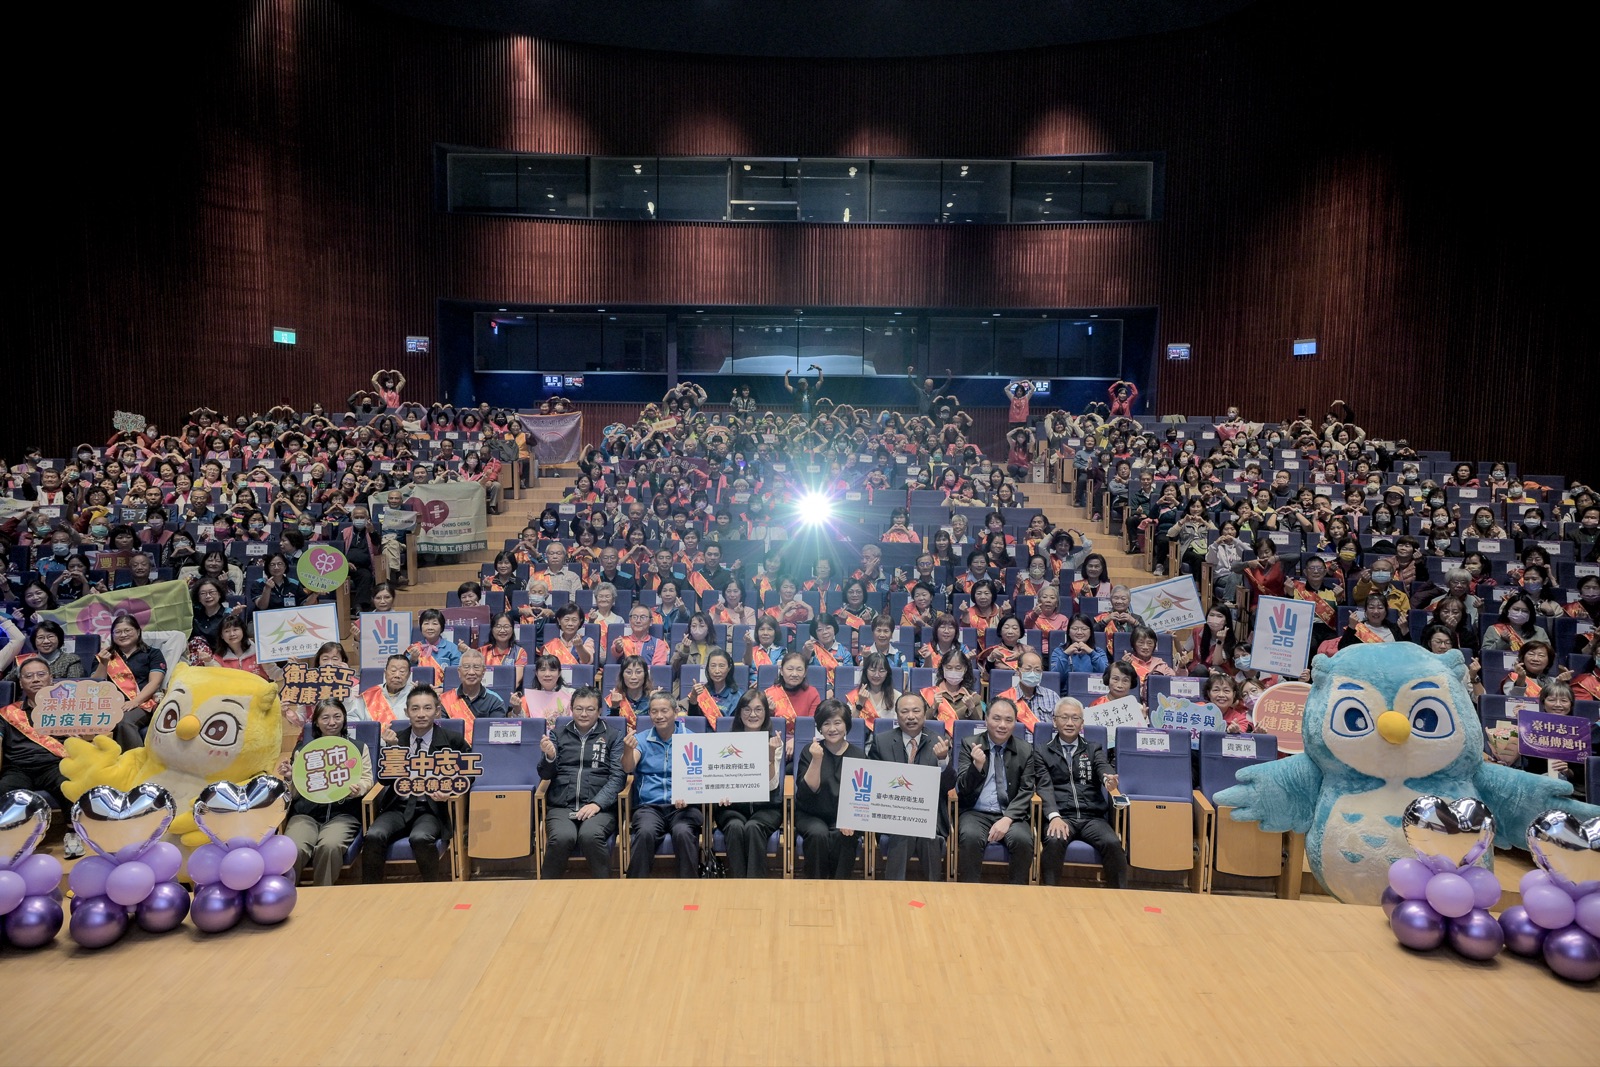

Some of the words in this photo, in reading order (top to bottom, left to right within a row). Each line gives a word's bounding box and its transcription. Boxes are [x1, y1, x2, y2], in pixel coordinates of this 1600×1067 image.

[1272, 635, 1294, 648] 26
[378, 645, 399, 655] 26
[284, 664, 355, 686] 衛愛志工
[43, 697, 112, 711] 深耕社區
[41, 712, 111, 727] 防疫有力
[1163, 710, 1215, 727] 高齡參與
[494, 730, 517, 738] 貴賓席
[1532, 720, 1580, 736] 臺中志工
[1141, 737, 1165, 746] 貴賓席
[1227, 743, 1251, 752] 貴賓席
[1527, 733, 1587, 751] 幸福傳遞中
[304, 746, 347, 770] 富市
[380, 748, 483, 777] 臺中志工
[687, 766, 703, 775] 26
[708, 763, 755, 771] 臺中市政府衛生局
[307, 767, 350, 792] 臺中
[398, 779, 466, 793] 幸福傳遞中
[854, 793, 871, 802] 26
[876, 793, 925, 804] 臺中市政府衛生局
